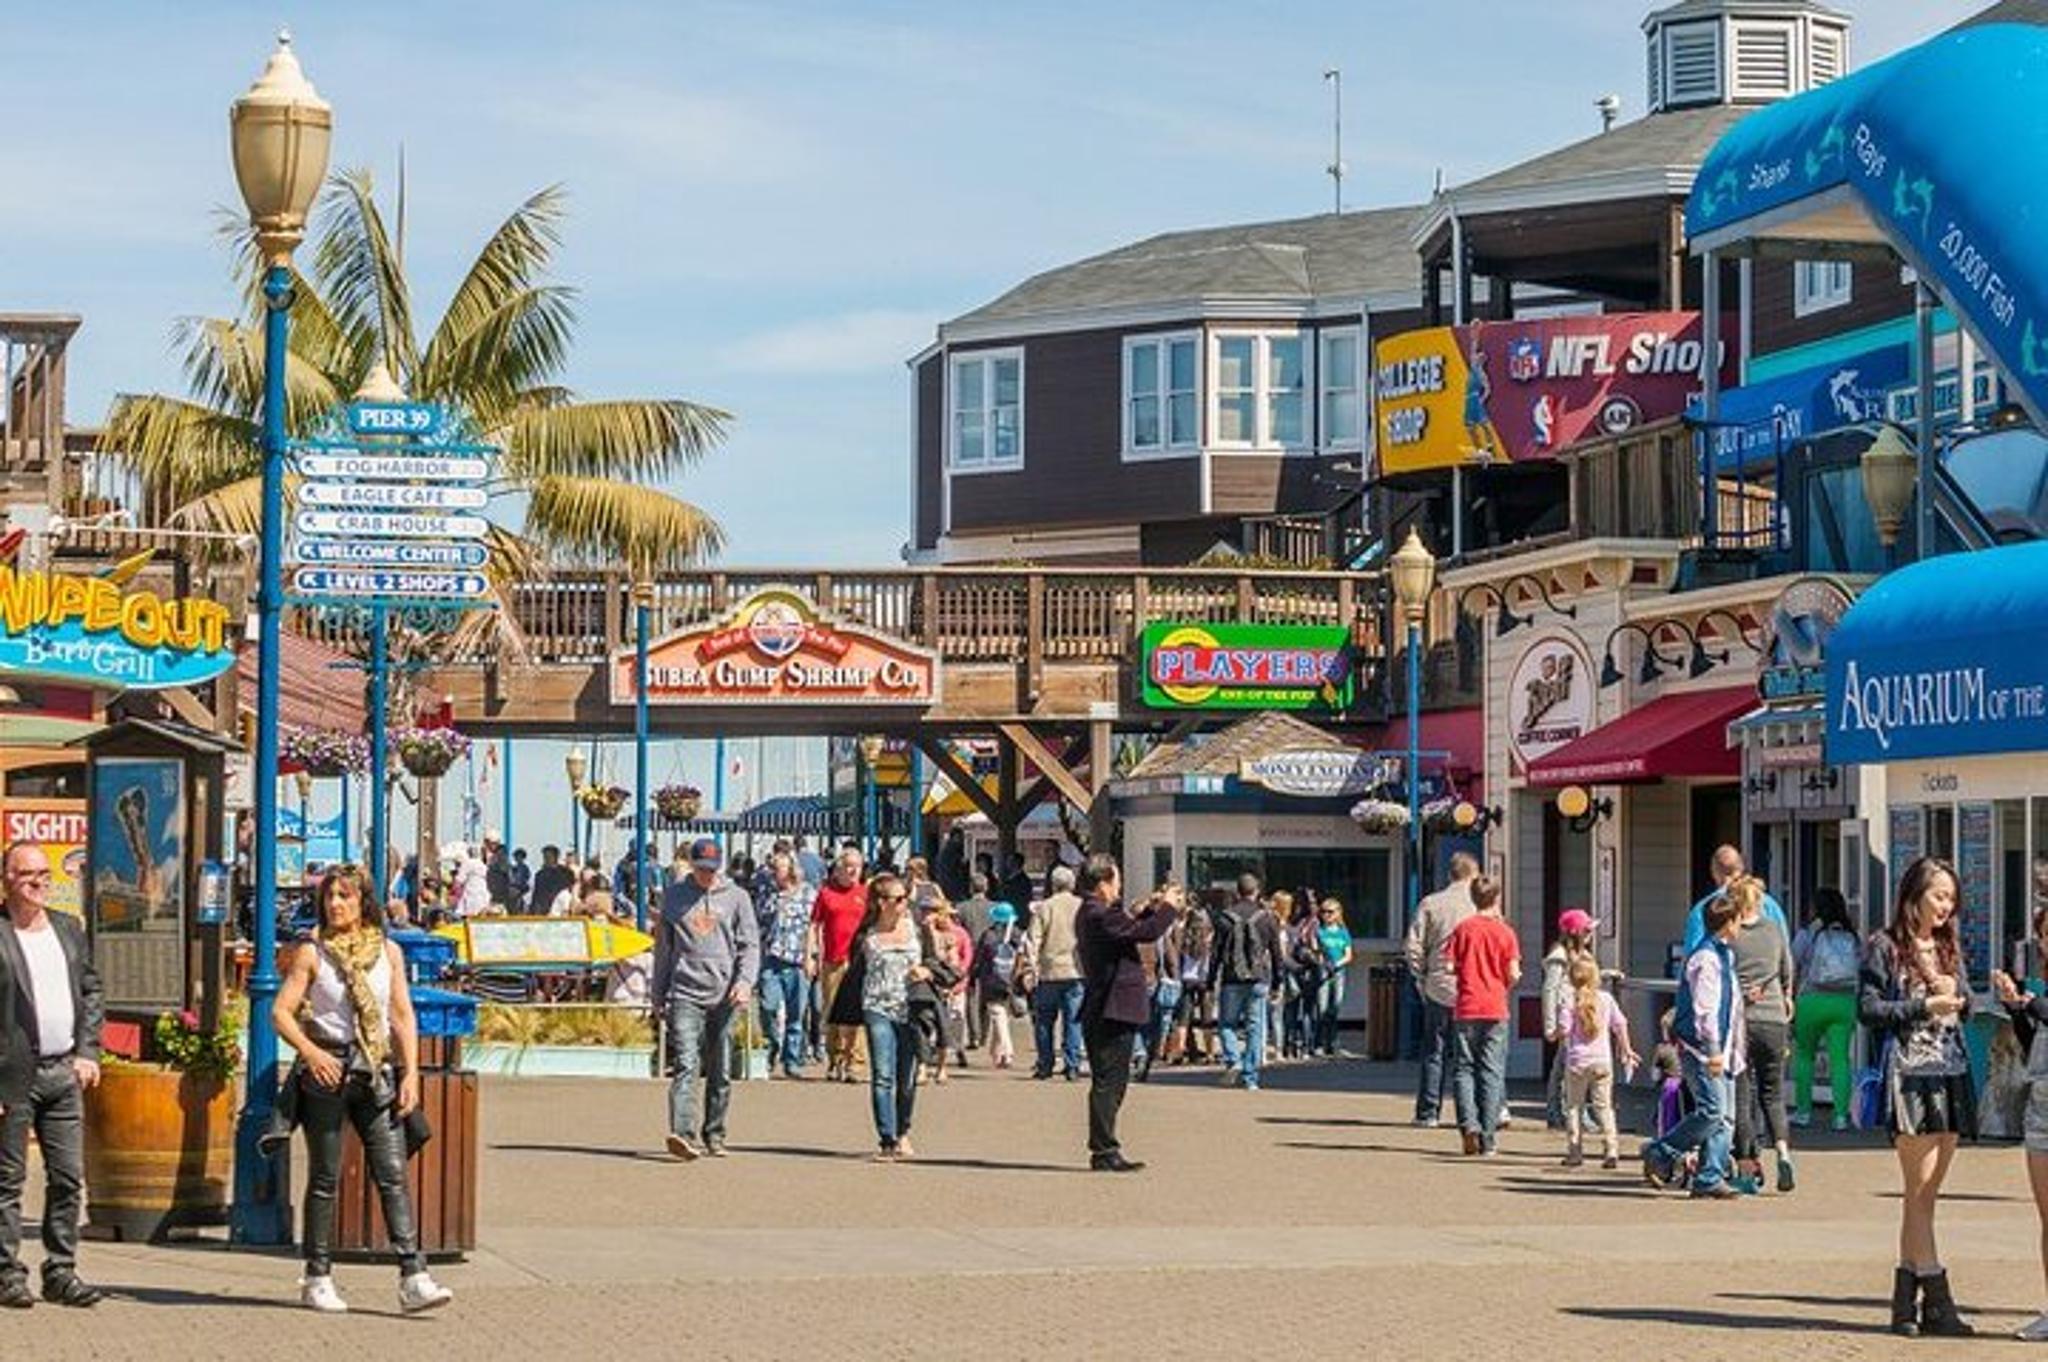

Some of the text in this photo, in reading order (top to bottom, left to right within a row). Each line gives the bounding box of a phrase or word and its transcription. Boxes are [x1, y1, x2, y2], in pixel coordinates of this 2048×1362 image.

[1981, 273, 2016, 328] Fish
[1546, 335, 1615, 376] NFL
[1380, 356, 1443, 399] LLEGE
[360, 409, 431, 429] PIER 39
[335, 460, 452, 476] FOG HARBOR
[340, 488, 444, 505] EAGLE CAFE
[335, 516, 448, 533] CRAB HOUSE
[317, 544, 462, 562] WELCOME CENTER
[326, 573, 459, 592] LEVEL 2 SHOPS
[93, 640, 155, 681] Grill
[1157, 650, 1344, 681] PLAYERS
[1986, 689, 2009, 720] OF
[2013, 683, 2045, 718] THE
